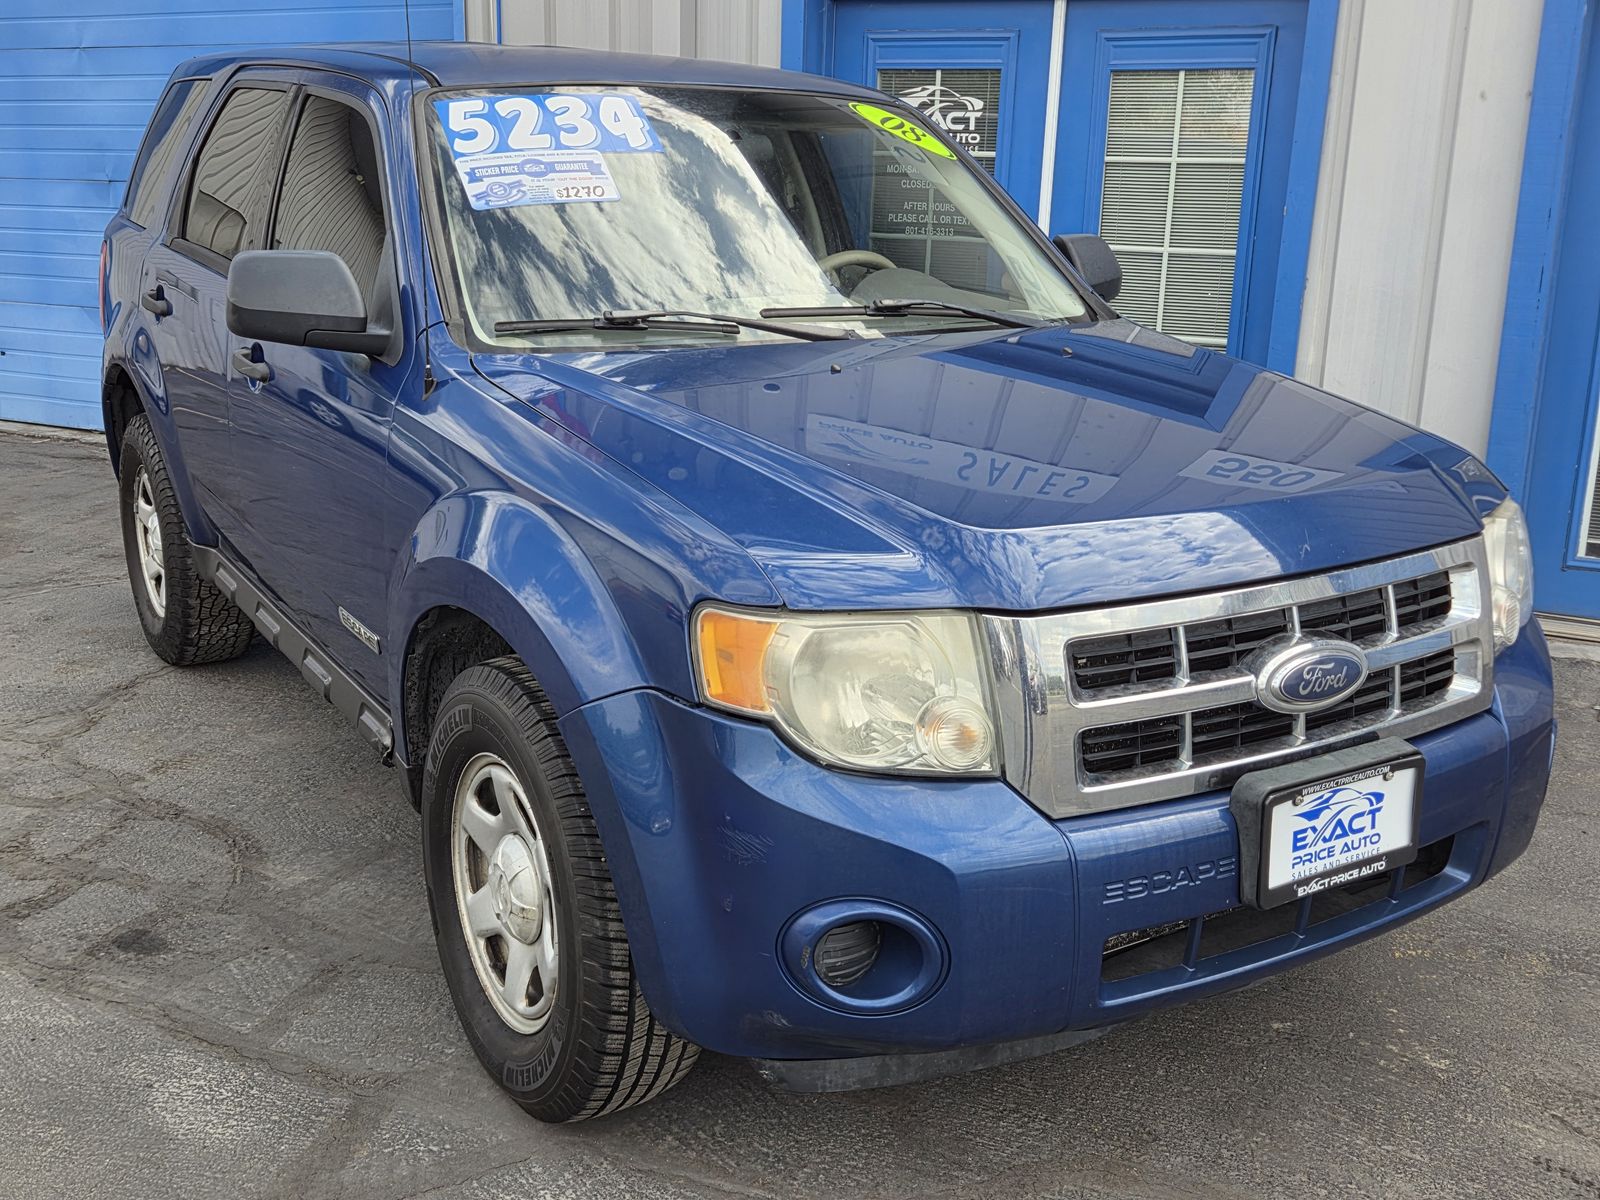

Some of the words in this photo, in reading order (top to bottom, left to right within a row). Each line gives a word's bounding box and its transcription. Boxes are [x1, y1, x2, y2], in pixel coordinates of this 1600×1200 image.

[449, 96, 652, 154] 5234
[880, 117, 927, 142] 08
[931, 111, 983, 130] ACT
[474, 166, 500, 177] STICKER
[501, 165, 519, 175] PRICE
[554, 162, 589, 171] GUARANTEE
[556, 185, 605, 198] $1270
[901, 180, 932, 189] CLOSED
[888, 213, 917, 223] PLEASE
[919, 214, 938, 224] CALL
[940, 215, 951, 224] OR
[903, 202, 927, 211] AFTER
[929, 202, 956, 212] HOURS
[1300, 662, 1348, 695] Ford
[428, 706, 471, 774] MICHELIN
[1302, 766, 1391, 796] WWW.EXACTPRICEAUTO.COM
[1292, 806, 1383, 853] EXACT
[1292, 845, 1336, 869] PRICE
[1339, 833, 1381, 855] AUTO
[1292, 865, 1318, 880] SALES
[1323, 859, 1340, 870] AND
[1345, 847, 1381, 864] SERVICE
[1103, 858, 1236, 904] ESCAPE
[1298, 878, 1330, 897] EXACT
[1330, 869, 1359, 885] PRICE
[1360, 861, 1386, 875] AUTO
[505, 1038, 562, 1088] MICHELIN
